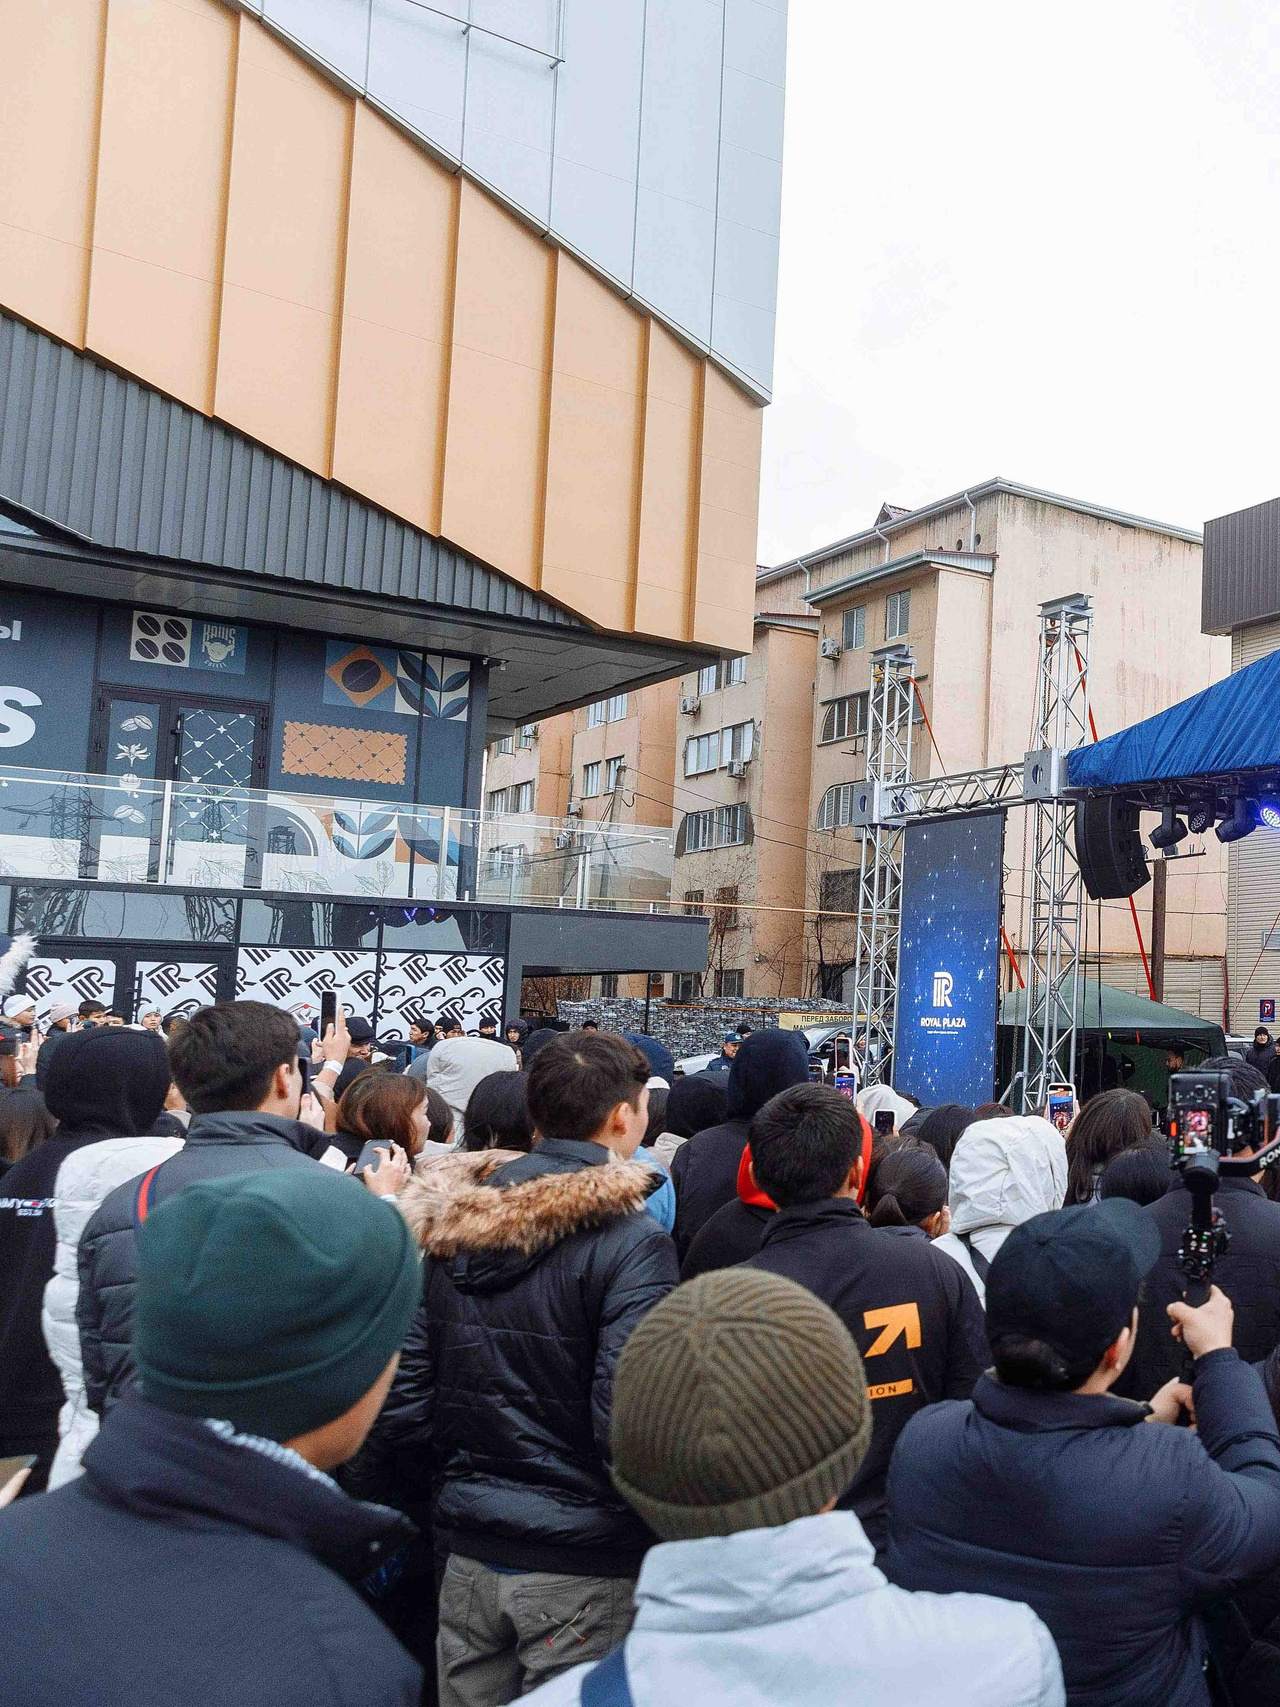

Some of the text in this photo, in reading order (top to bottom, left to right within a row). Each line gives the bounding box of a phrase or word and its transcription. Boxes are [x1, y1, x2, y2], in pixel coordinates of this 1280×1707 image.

[825, 1015, 854, 1023] ЗАБОРО
[920, 1018, 967, 1028] ROYAL PLAZA
[869, 1385, 897, 1397] ION
